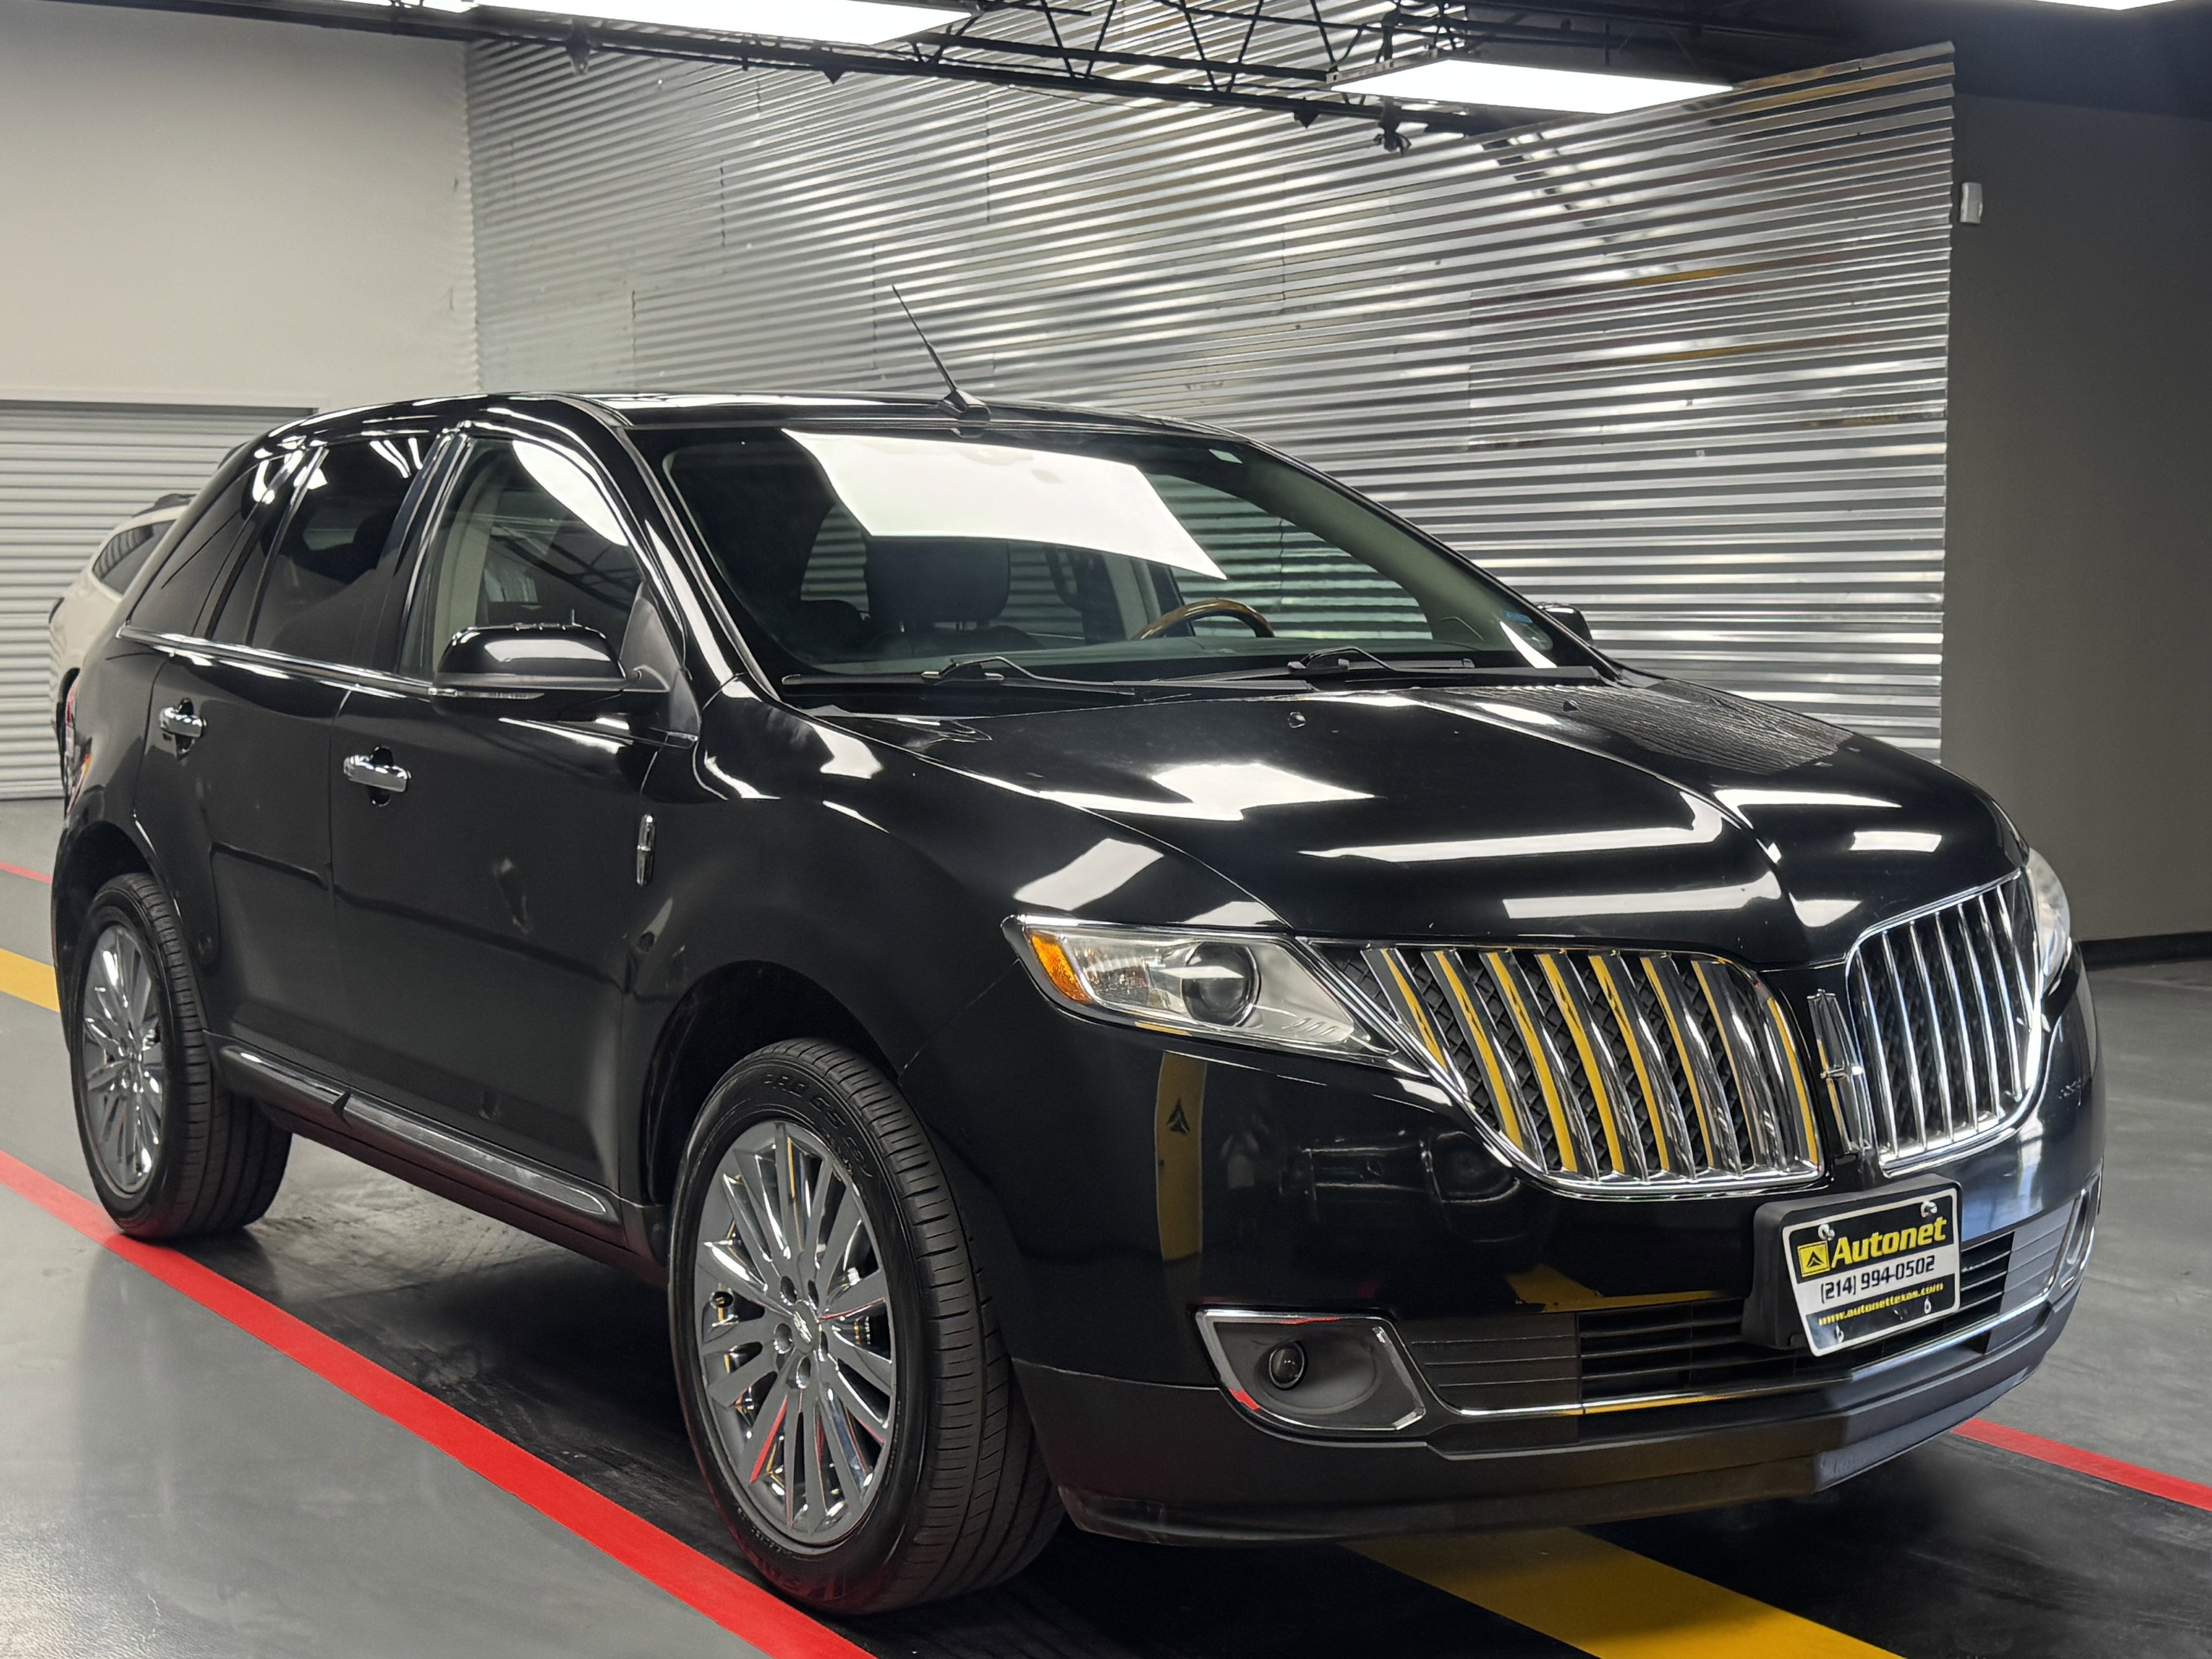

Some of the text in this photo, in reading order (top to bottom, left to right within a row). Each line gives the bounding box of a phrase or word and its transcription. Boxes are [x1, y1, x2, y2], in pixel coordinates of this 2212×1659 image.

[1831, 1217, 1947, 1268] Autonet
[1821, 1255, 1935, 1304] (214) 994-0502
[1819, 1283, 1943, 1326] www.autonettexas.com
